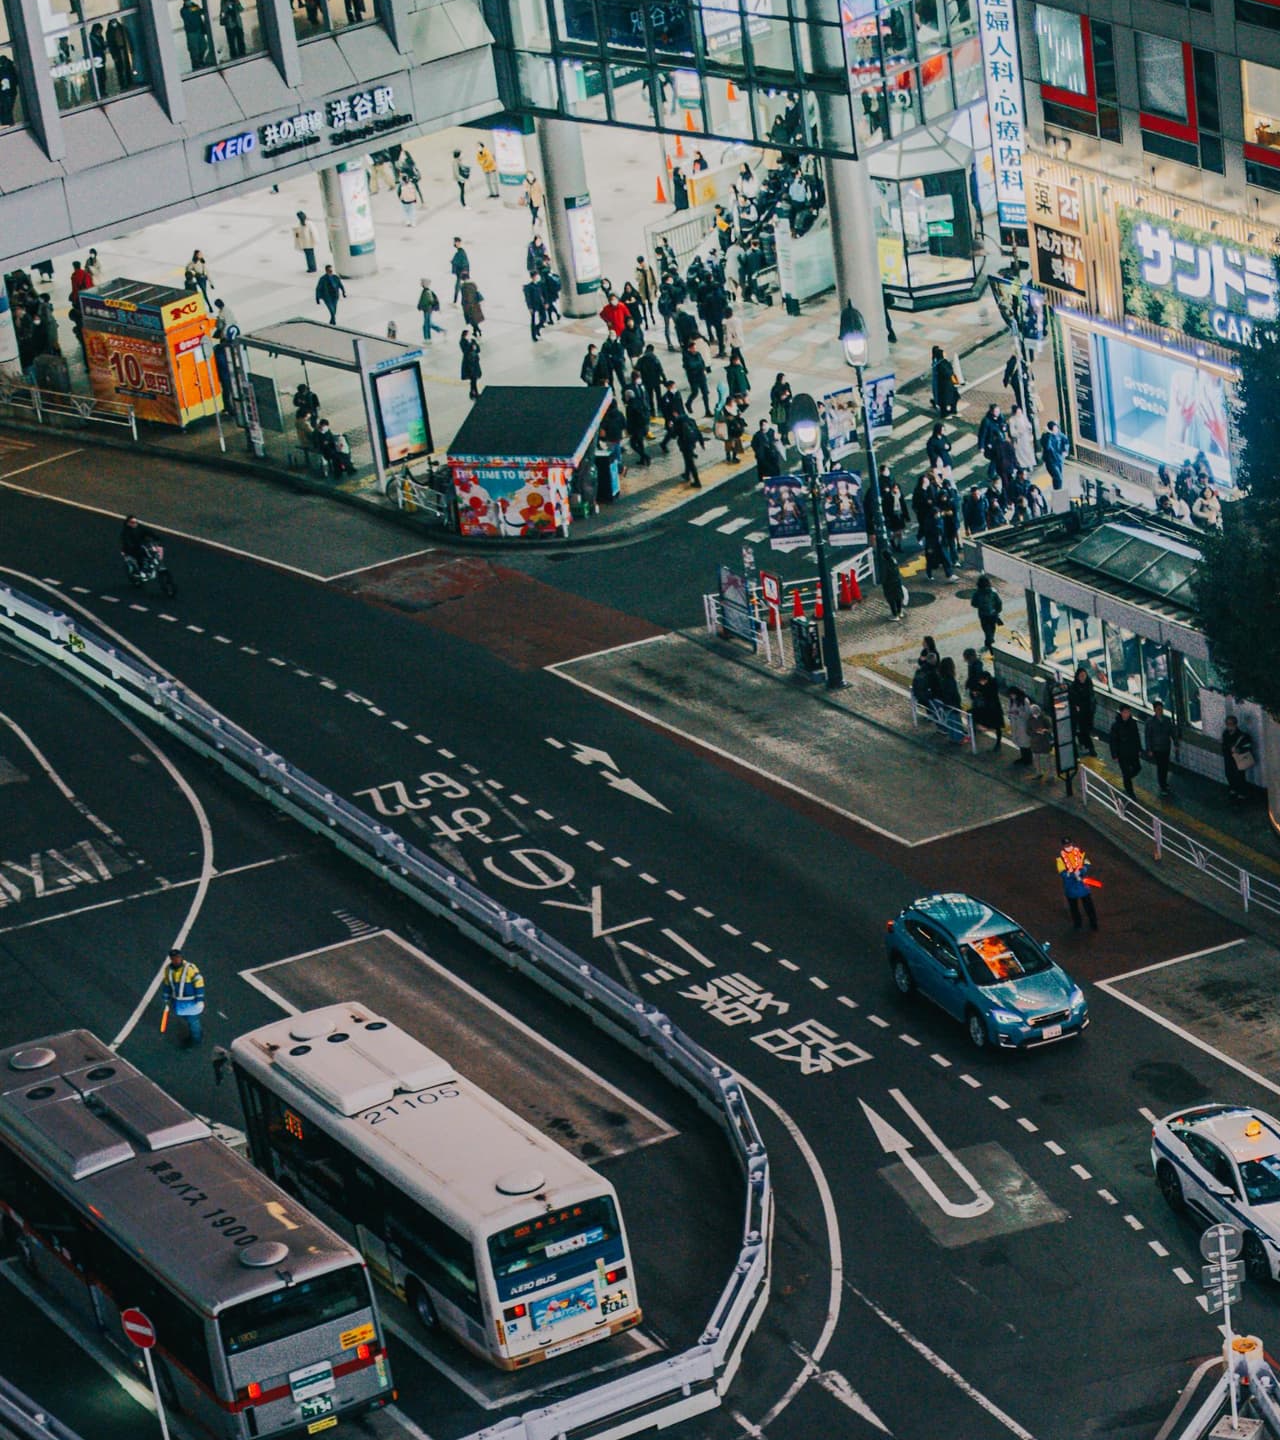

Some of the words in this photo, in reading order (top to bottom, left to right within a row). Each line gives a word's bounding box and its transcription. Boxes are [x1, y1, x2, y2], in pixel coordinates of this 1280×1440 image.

[210, 132, 256, 164] KEIO
[331, 86, 396, 129] 渋谷駅
[1034, 181, 1054, 217] 薬
[1036, 229, 1085, 262] 処方せん
[1051, 256, 1078, 285] 受付
[476, 470, 501, 480] TIME
[502, 470, 516, 479] TO
[363, 1085, 462, 1126] 21105
[203, 1207, 258, 1247] 1900
[536, 1272, 558, 1288] BUS
